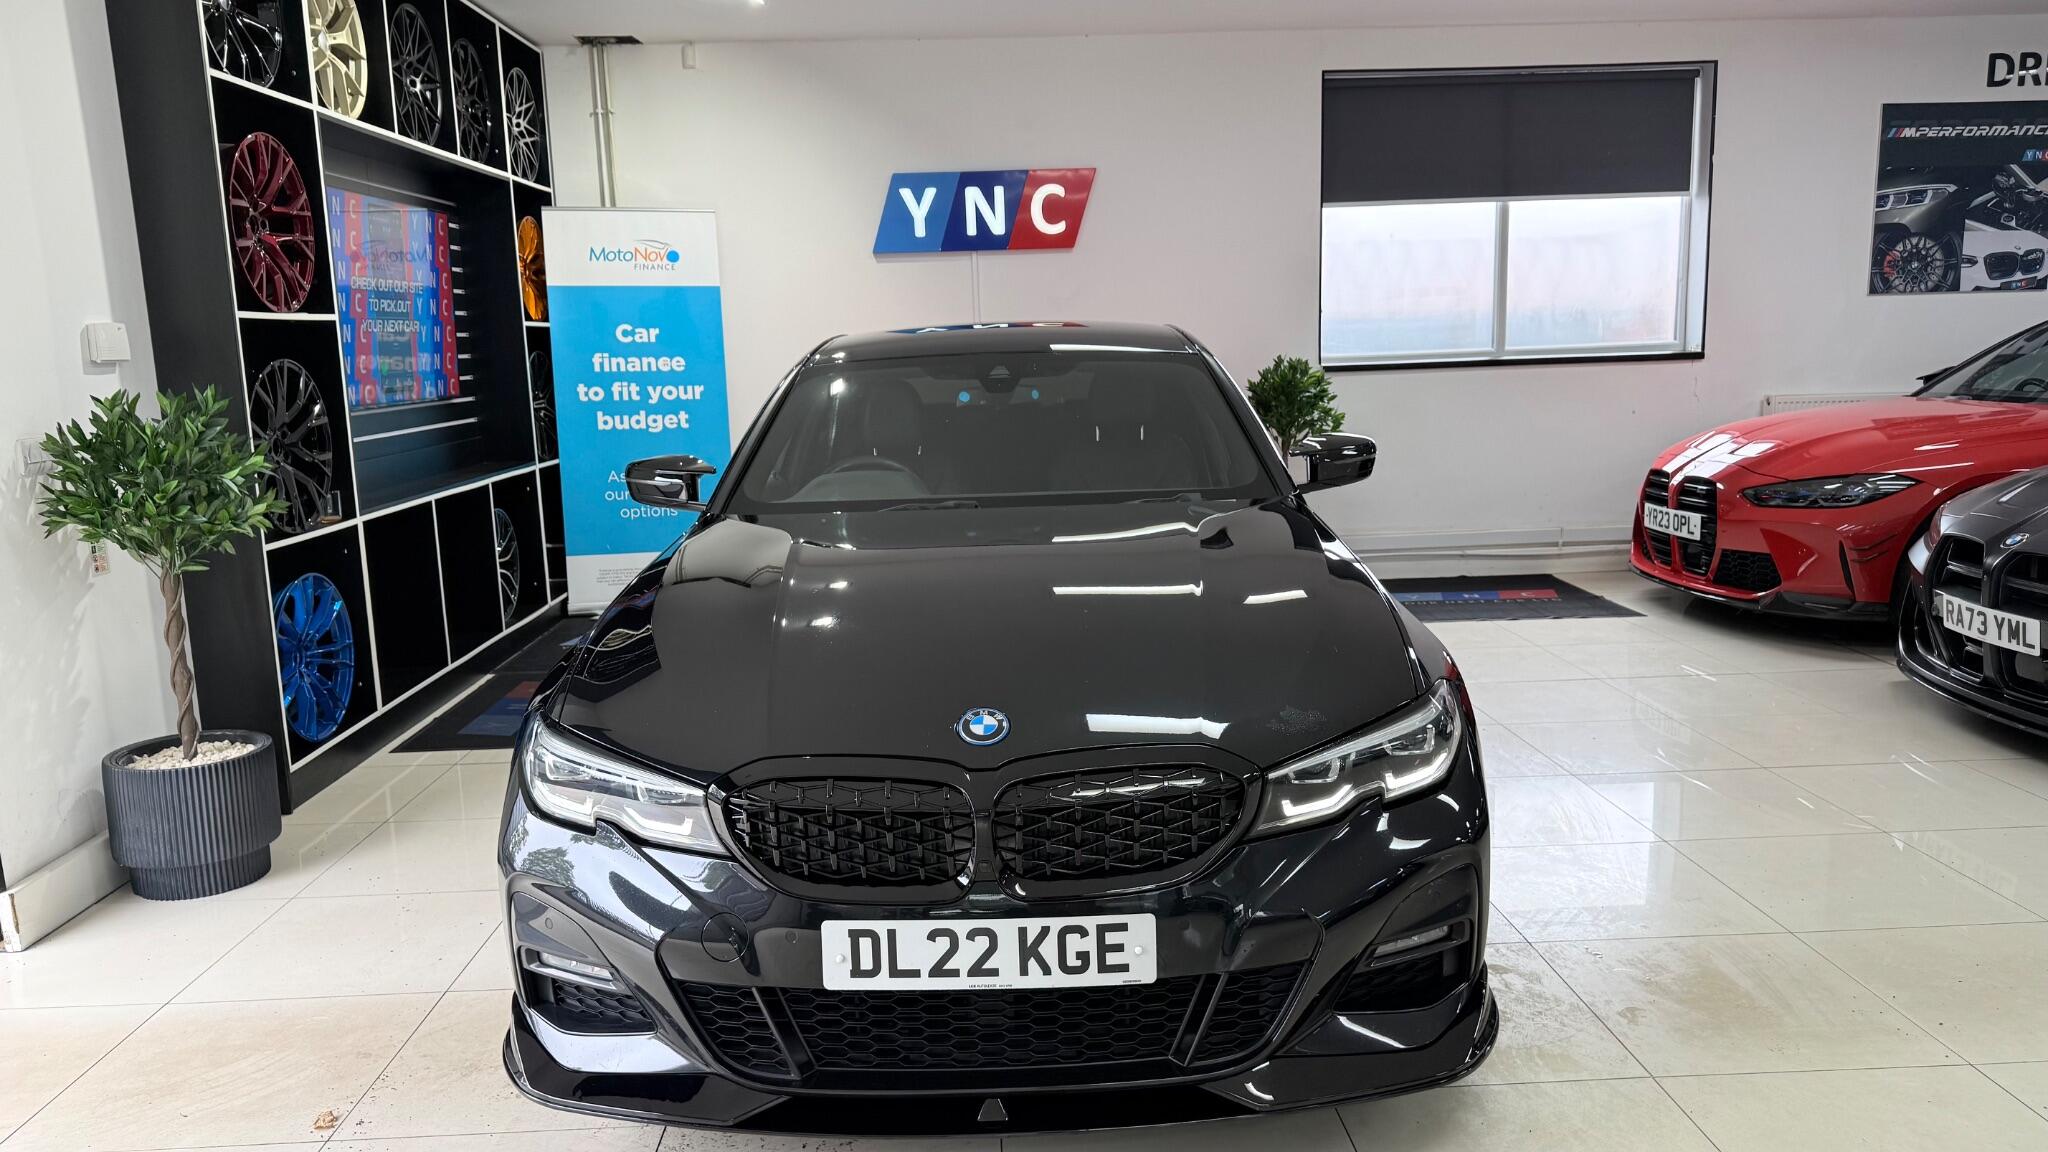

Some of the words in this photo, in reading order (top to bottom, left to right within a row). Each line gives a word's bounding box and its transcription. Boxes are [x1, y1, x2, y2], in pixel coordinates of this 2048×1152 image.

[1986, 51, 2048, 88] DR
[898, 183, 1067, 238] YNC
[589, 246, 680, 263] MotoNovo
[633, 263, 677, 271] FINANCE
[351, 277, 377, 291] CHECK
[379, 279, 394, 292] OUT
[394, 281, 409, 293] OUR
[409, 282, 424, 294] SITE
[369, 299, 379, 312] TO
[381, 299, 396, 312] PICK
[397, 300, 411, 313] OUT
[363, 320, 383, 332] YOUR
[384, 320, 404, 333] NEXT
[404, 320, 420, 333] CAR
[615, 323, 660, 343] Car
[592, 353, 686, 372] finance
[576, 383, 605, 402] to
[611, 381, 641, 401] fit
[647, 384, 704, 404] your
[596, 410, 690, 432] budget
[607, 470, 627, 483] As
[620, 504, 678, 520] options
[1647, 506, 1670, 529] YR23
[1672, 513, 1695, 535] OPL
[1945, 599, 1988, 636] RA73
[1993, 614, 2036, 650] YML
[847, 927, 1000, 979] DL22
[1017, 922, 1130, 977] KGE
